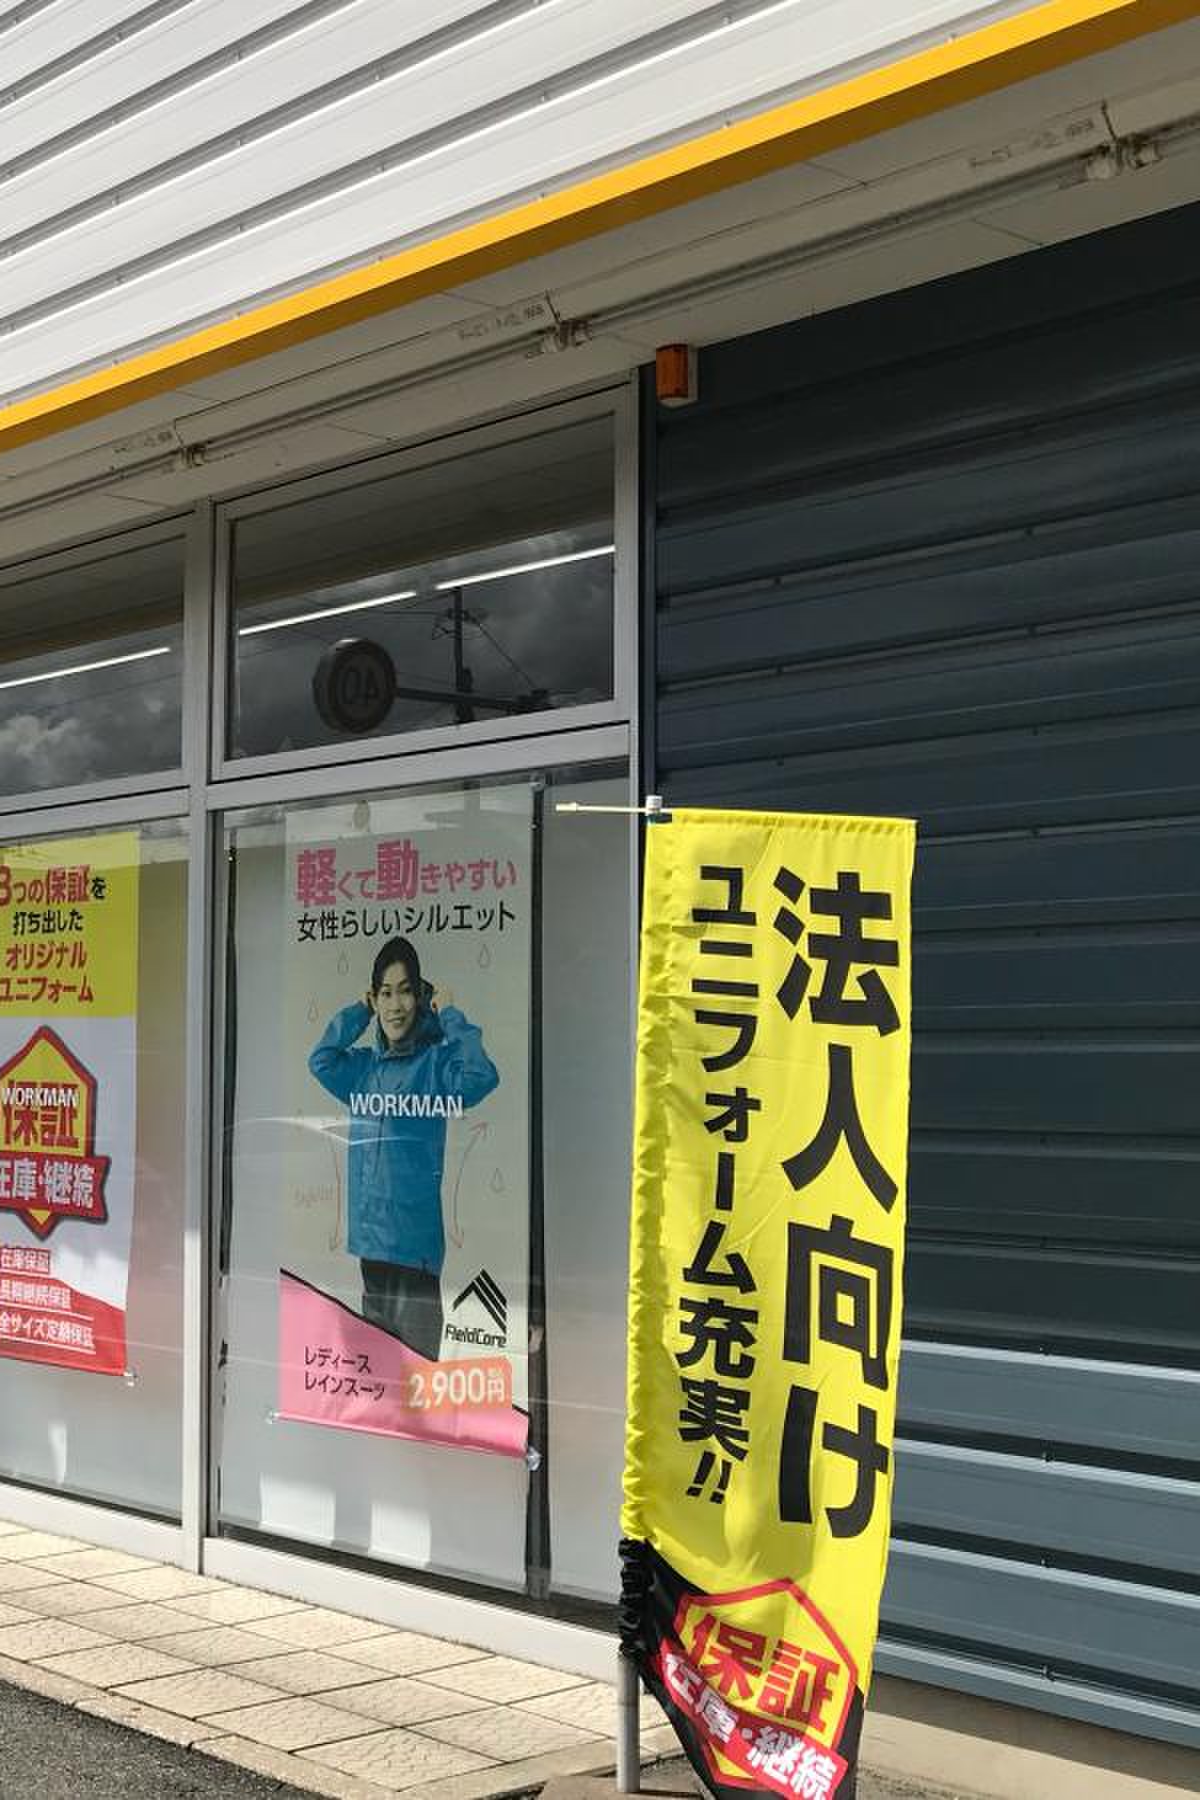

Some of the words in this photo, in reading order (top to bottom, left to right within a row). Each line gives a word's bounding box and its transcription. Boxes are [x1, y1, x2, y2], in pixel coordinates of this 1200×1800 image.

[296, 838, 518, 908] 軽くて動きやすい
[12, 908, 84, 936] 打ち出した
[297, 900, 516, 943] 女性らしいシルエット
[5, 940, 87, 971] オリジナル
[3, 1086, 80, 1108] WORKMAN
[349, 1092, 464, 1118] WORKMAN
[772, 866, 902, 1540] 法人向け
[445, 1323, 507, 1348] FieldCore
[305, 1345, 372, 1375] レディース
[304, 1372, 386, 1401] レインスーツ
[686, 1613, 840, 1733] 保証
